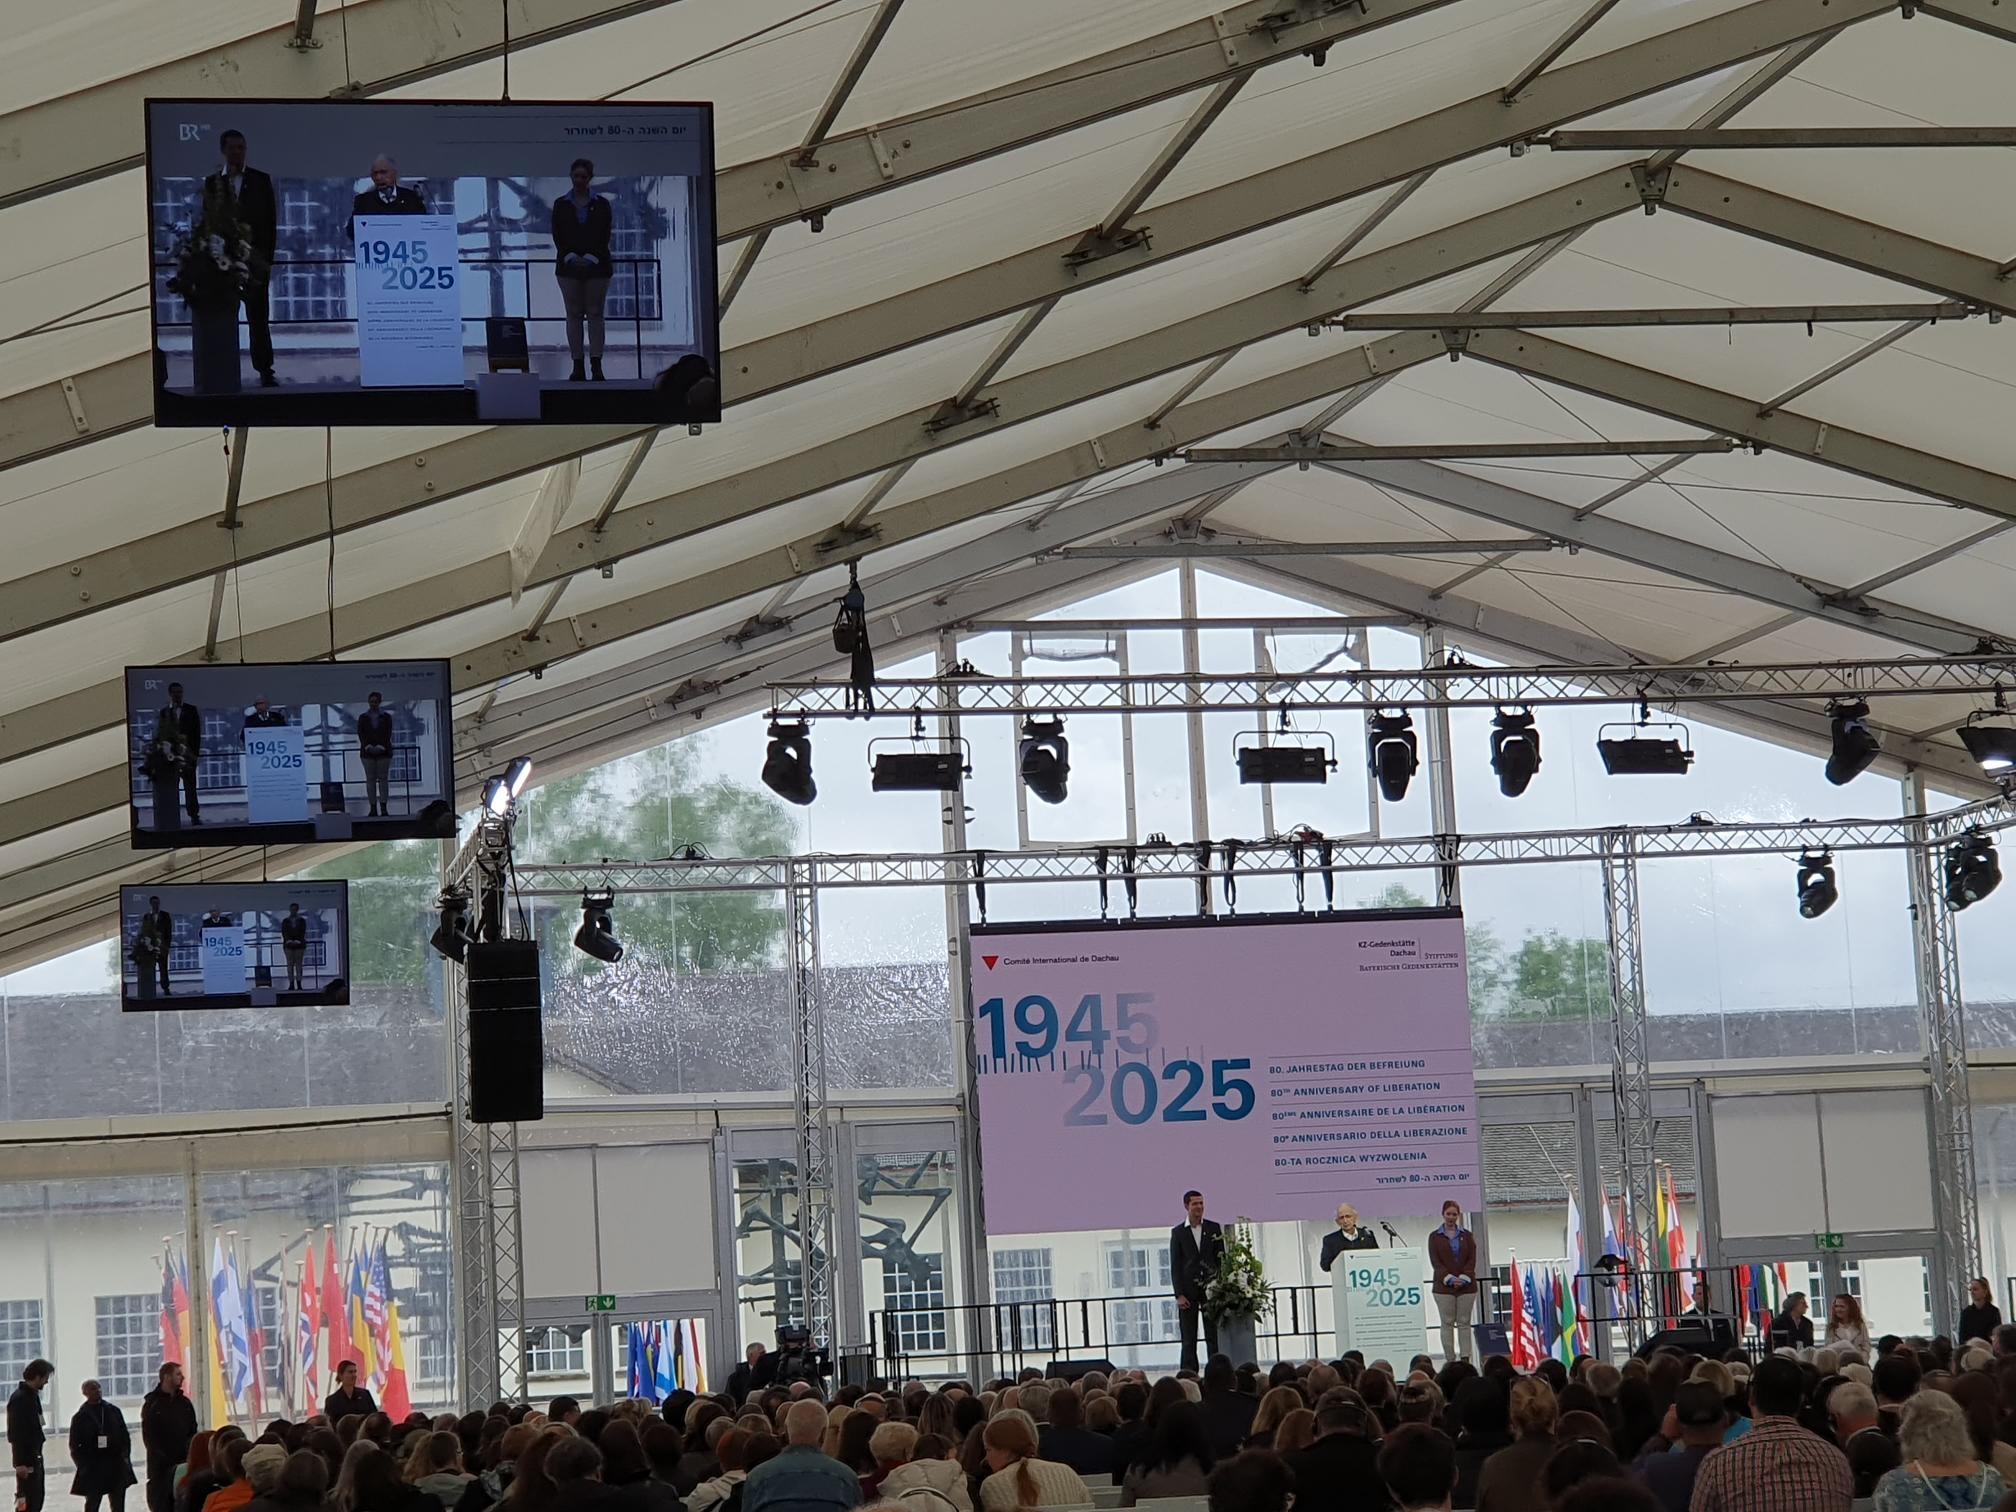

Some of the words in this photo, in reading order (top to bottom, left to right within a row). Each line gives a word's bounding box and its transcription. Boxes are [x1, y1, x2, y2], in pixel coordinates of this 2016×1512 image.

[180, 123, 200, 141] BR
[359, 240, 429, 265] 1945
[381, 266, 455, 290] 2025
[248, 740, 288, 755] 1945
[261, 754, 303, 769] 2025
[205, 936, 232, 947] 1945
[213, 946, 243, 957] 2025
[1390, 949, 1416, 957] Dachau
[1003, 957, 1031, 966] Comité
[1032, 955, 1078, 965] International
[1079, 955, 1089, 963] de
[1091, 954, 1120, 963] Dachau
[979, 992, 1160, 1059] 1945
[1269, 1066, 1284, 1074] 80.
[1286, 1063, 1344, 1074] JAHRESTAG
[1347, 1062, 1367, 1071] DER
[1369, 1059, 1426, 1070] BEFREIUNG
[1062, 1058, 1256, 1127] 2025
[1293, 1086, 1365, 1096] ANNIVERSARY
[1368, 1084, 1380, 1093] OF
[1383, 1082, 1441, 1092] LIBERATION
[1299, 1108, 1374, 1119] ANNIVERSAIRE
[1377, 1107, 1390, 1116] DE
[1392, 1107, 1405, 1115] LA
[1407, 1104, 1466, 1114] LIBÉRATION
[1291, 1132, 1367, 1143] ANNIVERSARIO
[1370, 1130, 1400, 1139] DELLA
[1403, 1127, 1468, 1137] LIBERAZIONE
[1274, 1158, 1302, 1167] 80-TA
[1305, 1155, 1356, 1165] ROCZNICA
[1359, 1152, 1427, 1163] WYZWOLENIA
[1349, 1268, 1400, 1288] 1945
[1366, 1287, 1421, 1307] 2025
